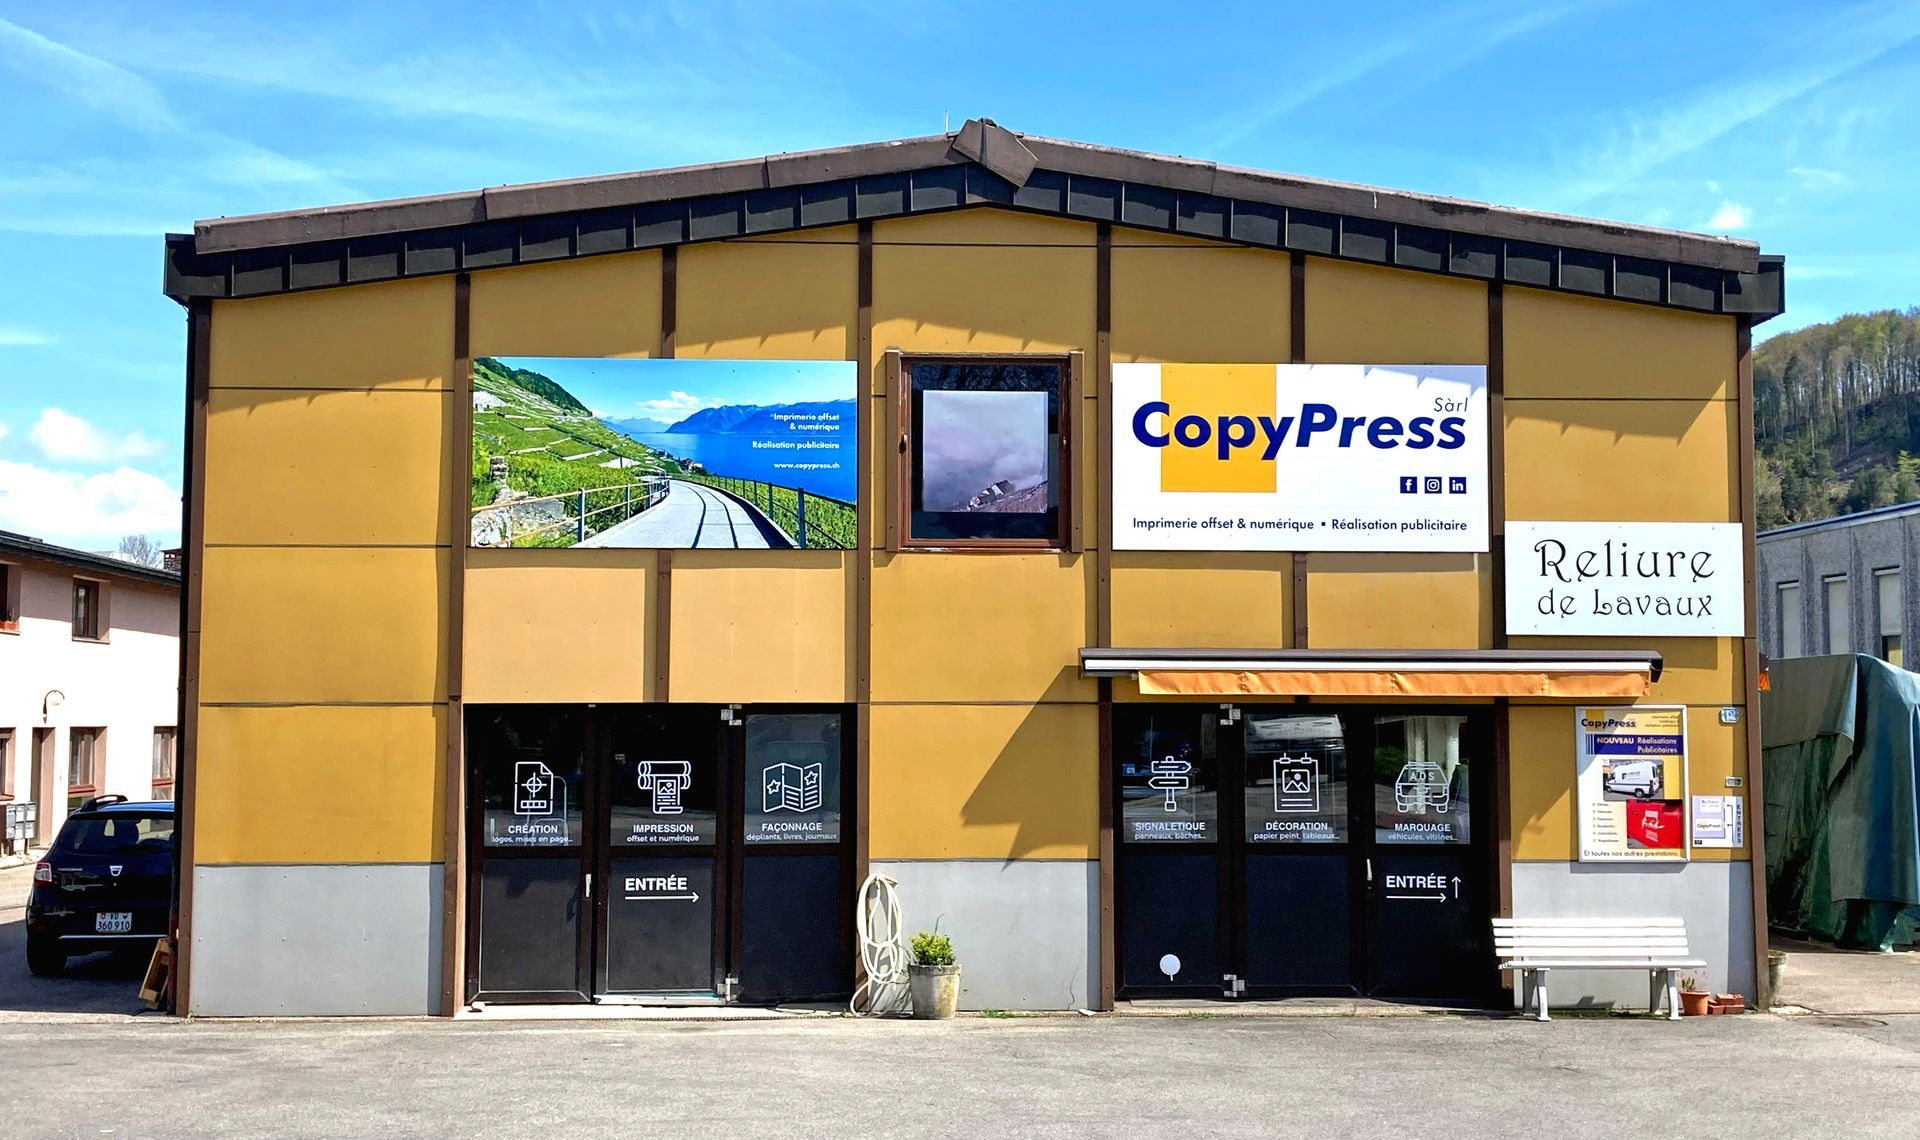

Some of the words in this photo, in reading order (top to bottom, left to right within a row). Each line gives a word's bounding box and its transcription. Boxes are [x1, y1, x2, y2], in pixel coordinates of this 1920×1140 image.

[1433, 396, 1468, 413] Sàrl
[773, 413, 816, 422] Imprimerie
[818, 412, 840, 421] offset
[798, 422, 840, 432] numérique
[1131, 401, 1466, 460] CopyPress
[752, 441, 795, 449] Réalisation
[797, 441, 840, 450] publicitaire
[773, 462, 840, 470] www.copypress.ch
[1133, 517, 1198, 531] Imprimerie
[1201, 517, 1233, 529] offset
[1237, 518, 1247, 529] &
[1250, 518, 1314, 532] numérique
[1332, 518, 1397, 530] Réalisation
[1401, 518, 1467, 533] publicitaire
[1534, 539, 1714, 583] Reliure
[1538, 588, 1577, 618] de
[1592, 588, 1713, 618] Lavaux
[1581, 718, 1636, 728] CopyPress
[1637, 736, 1677, 744] Réalisations
[1410, 771, 1435, 781] ADS
[633, 824, 694, 833] IMPRESSION
[761, 822, 823, 833] FAÇONNAGE
[1265, 820, 1328, 831] DÉCORATION
[1394, 823, 1451, 832] MARQUAGE
[658, 834, 700, 843] numérique
[1253, 832, 1278, 840] papier
[625, 874, 688, 892] ENTRÉE
[1386, 873, 1447, 889] ENTRÉE
[97, 921, 113, 931] 360
[114, 921, 130, 930] 910
